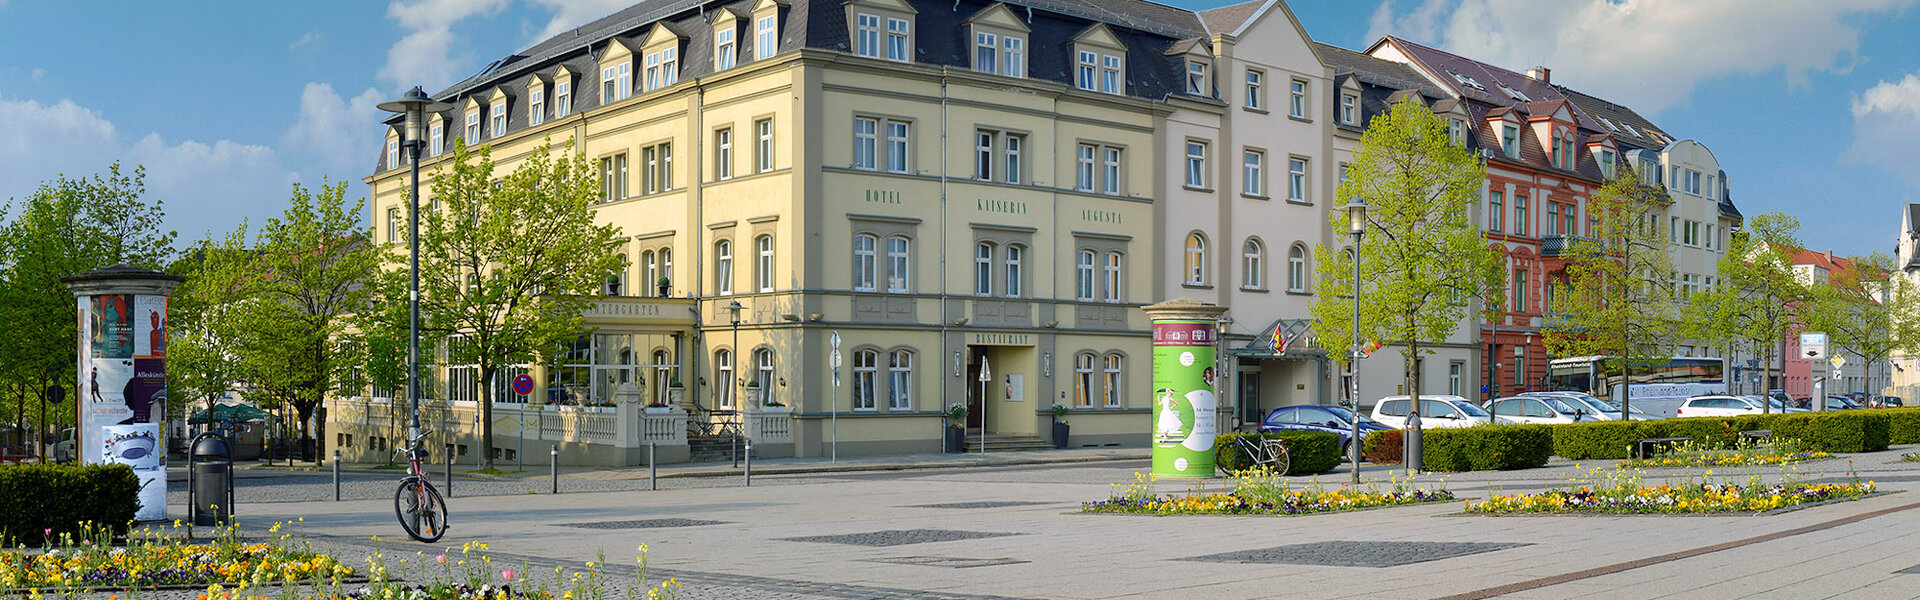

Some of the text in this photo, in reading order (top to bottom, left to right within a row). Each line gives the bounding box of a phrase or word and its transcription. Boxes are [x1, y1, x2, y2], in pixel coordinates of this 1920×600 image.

[865, 189, 1122, 224] HOTEL KAISERIN AUGUSTA
[976, 333, 1028, 345] RESTAURANT
